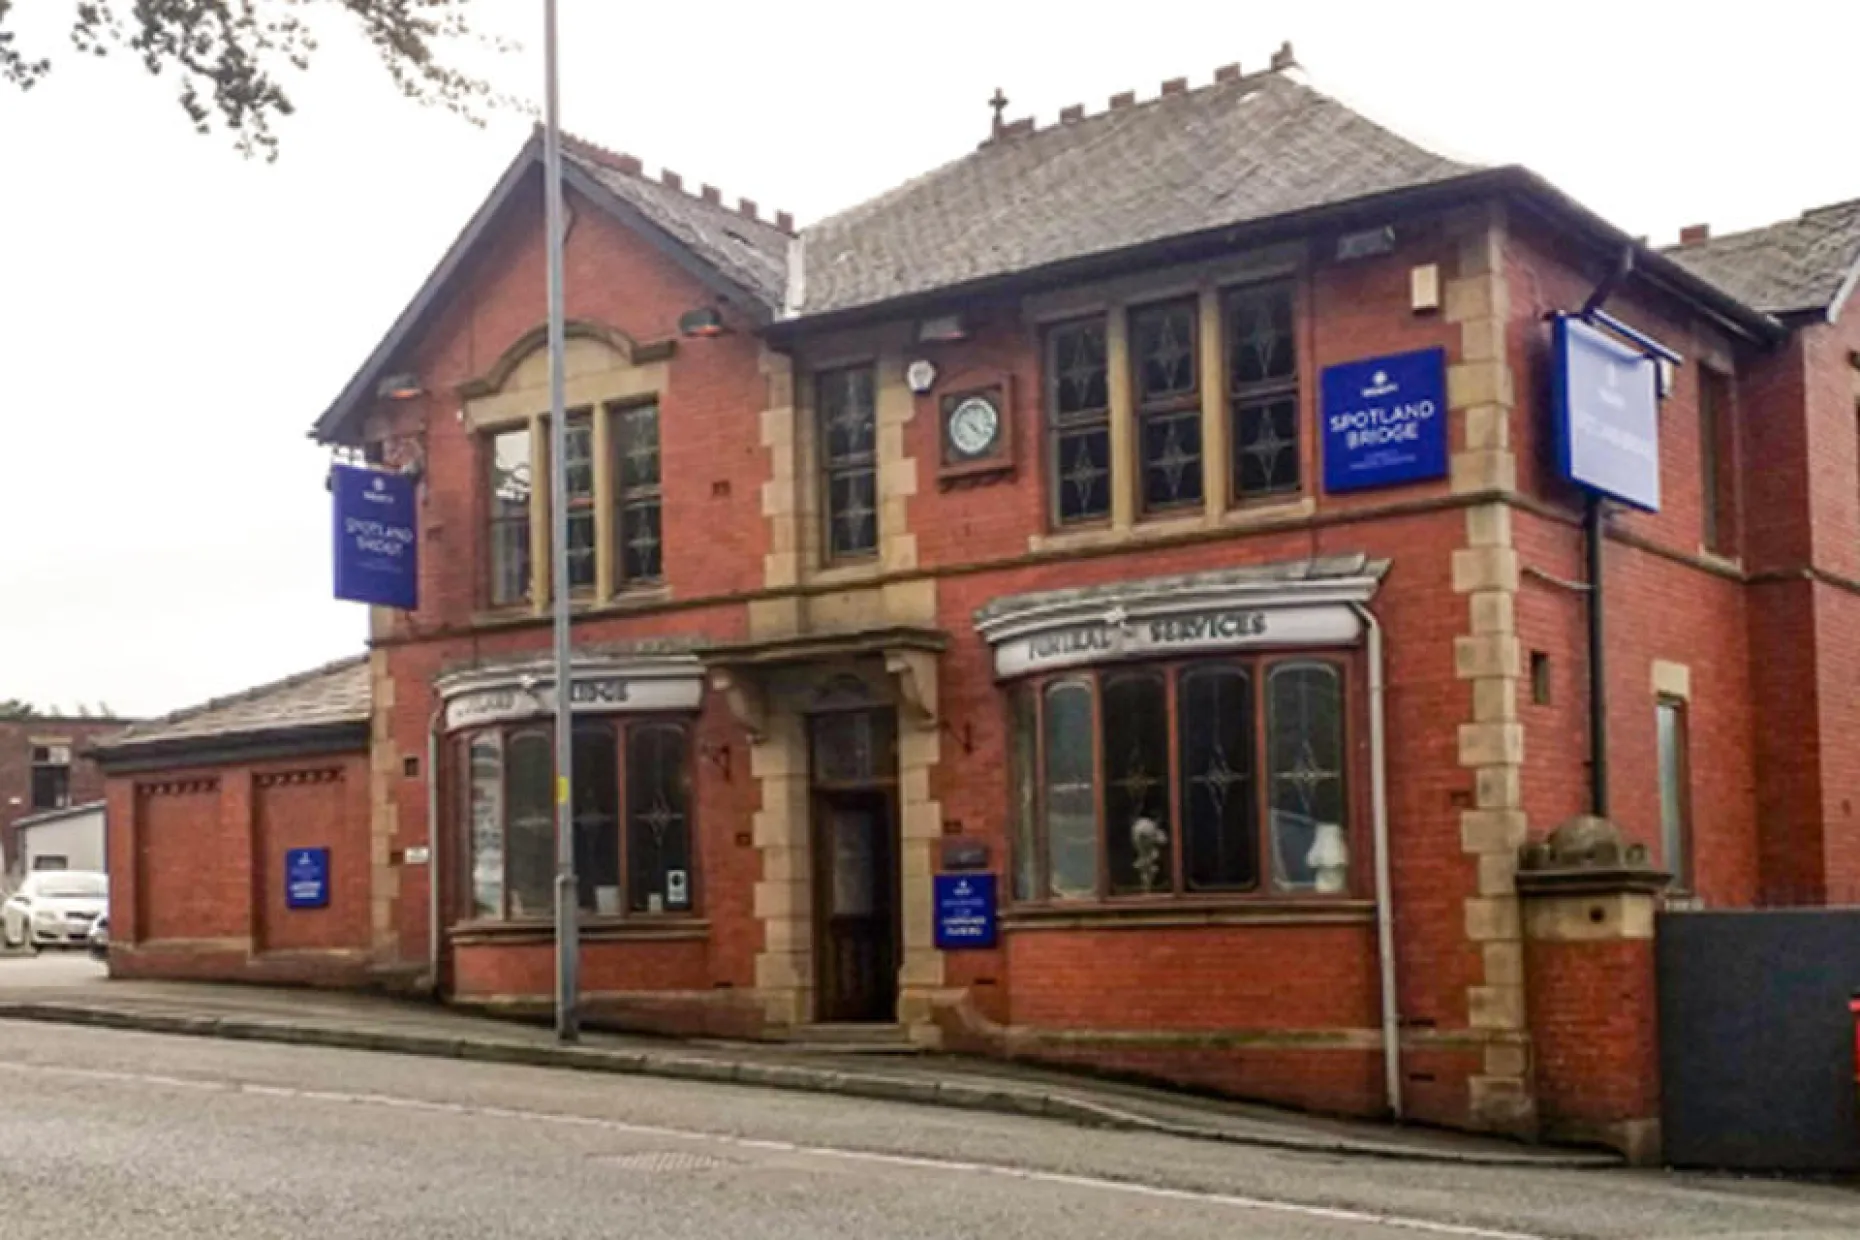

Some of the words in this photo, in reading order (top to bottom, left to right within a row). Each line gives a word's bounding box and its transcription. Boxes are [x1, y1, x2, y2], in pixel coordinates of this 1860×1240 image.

[1329, 399, 1435, 432] SPOTLAND
[1346, 422, 1418, 450] BRIDGE
[1149, 611, 1267, 643] SERVICES
